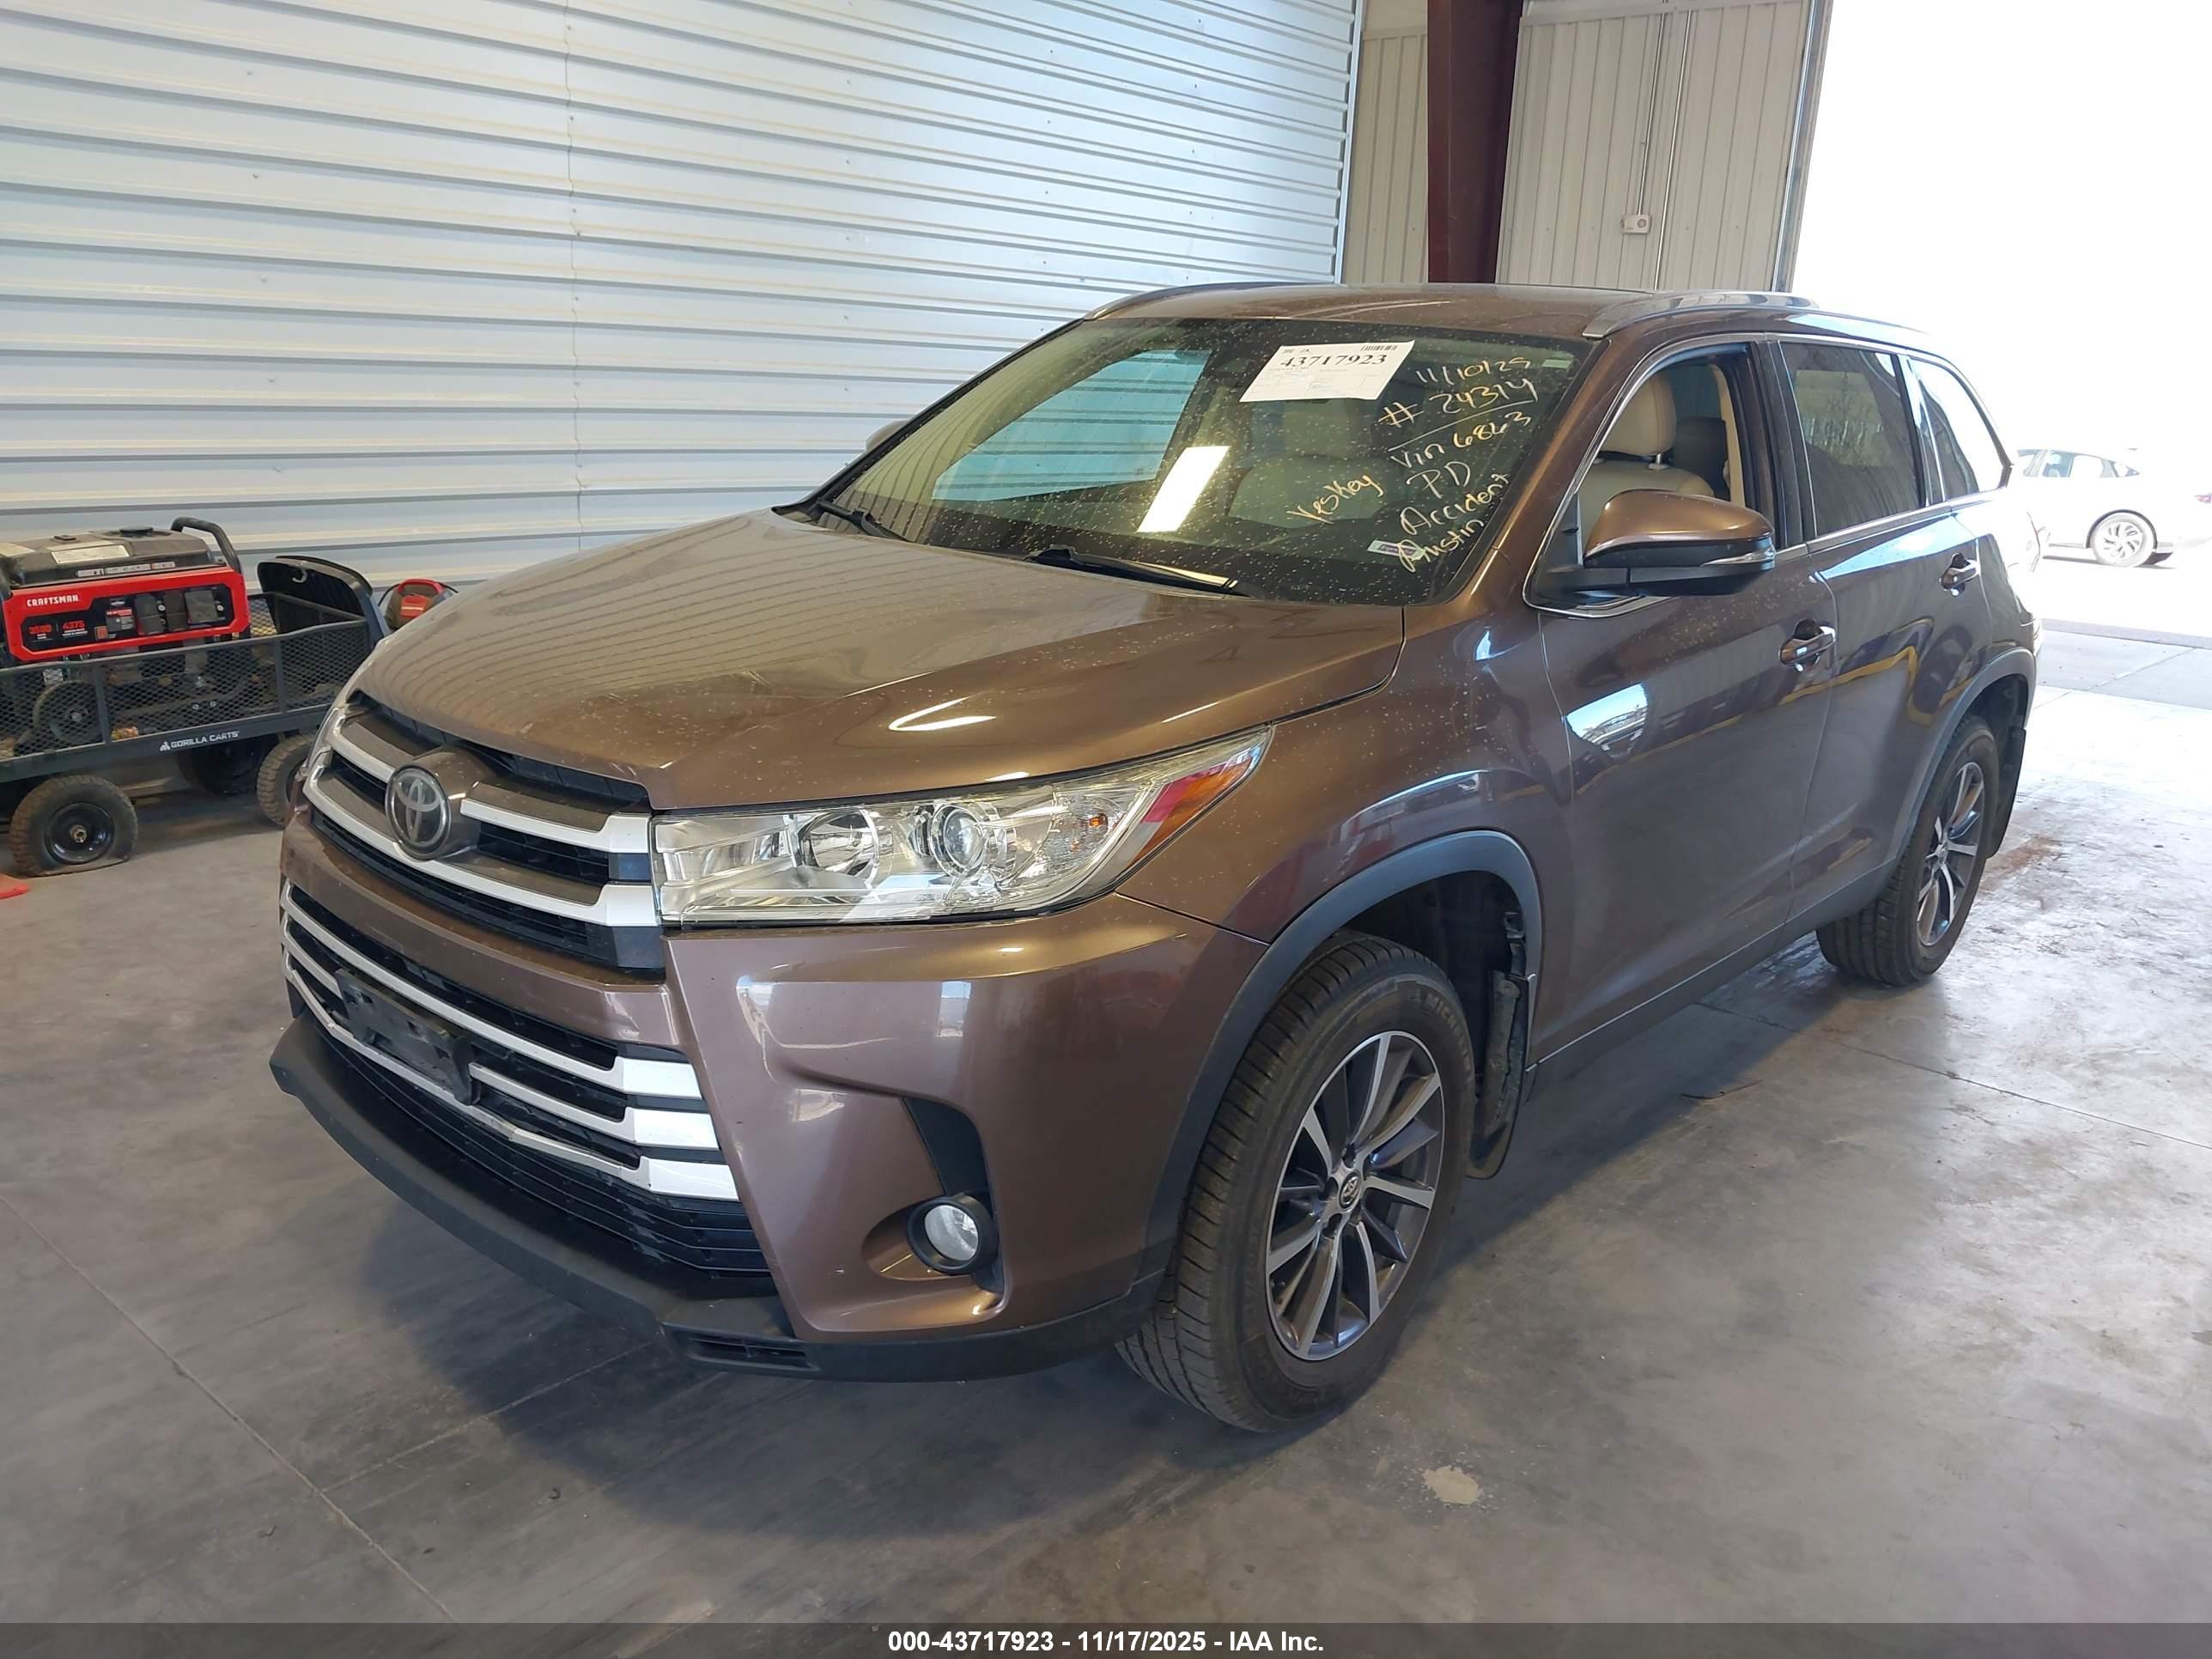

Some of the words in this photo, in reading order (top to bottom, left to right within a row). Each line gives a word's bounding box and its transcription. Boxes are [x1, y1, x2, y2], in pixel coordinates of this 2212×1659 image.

[1280, 354, 1388, 368] 43717923
[1377, 401, 1425, 428] #
[1428, 378, 1539, 414] 24314
[1406, 461, 1471, 500] PD
[1400, 473, 1510, 536] Accident
[1397, 519, 1485, 573] Austin
[27, 594, 79, 607] CRAFTSMAN
[171, 736, 208, 749] GORILLA
[209, 730, 239, 742] CARTS
